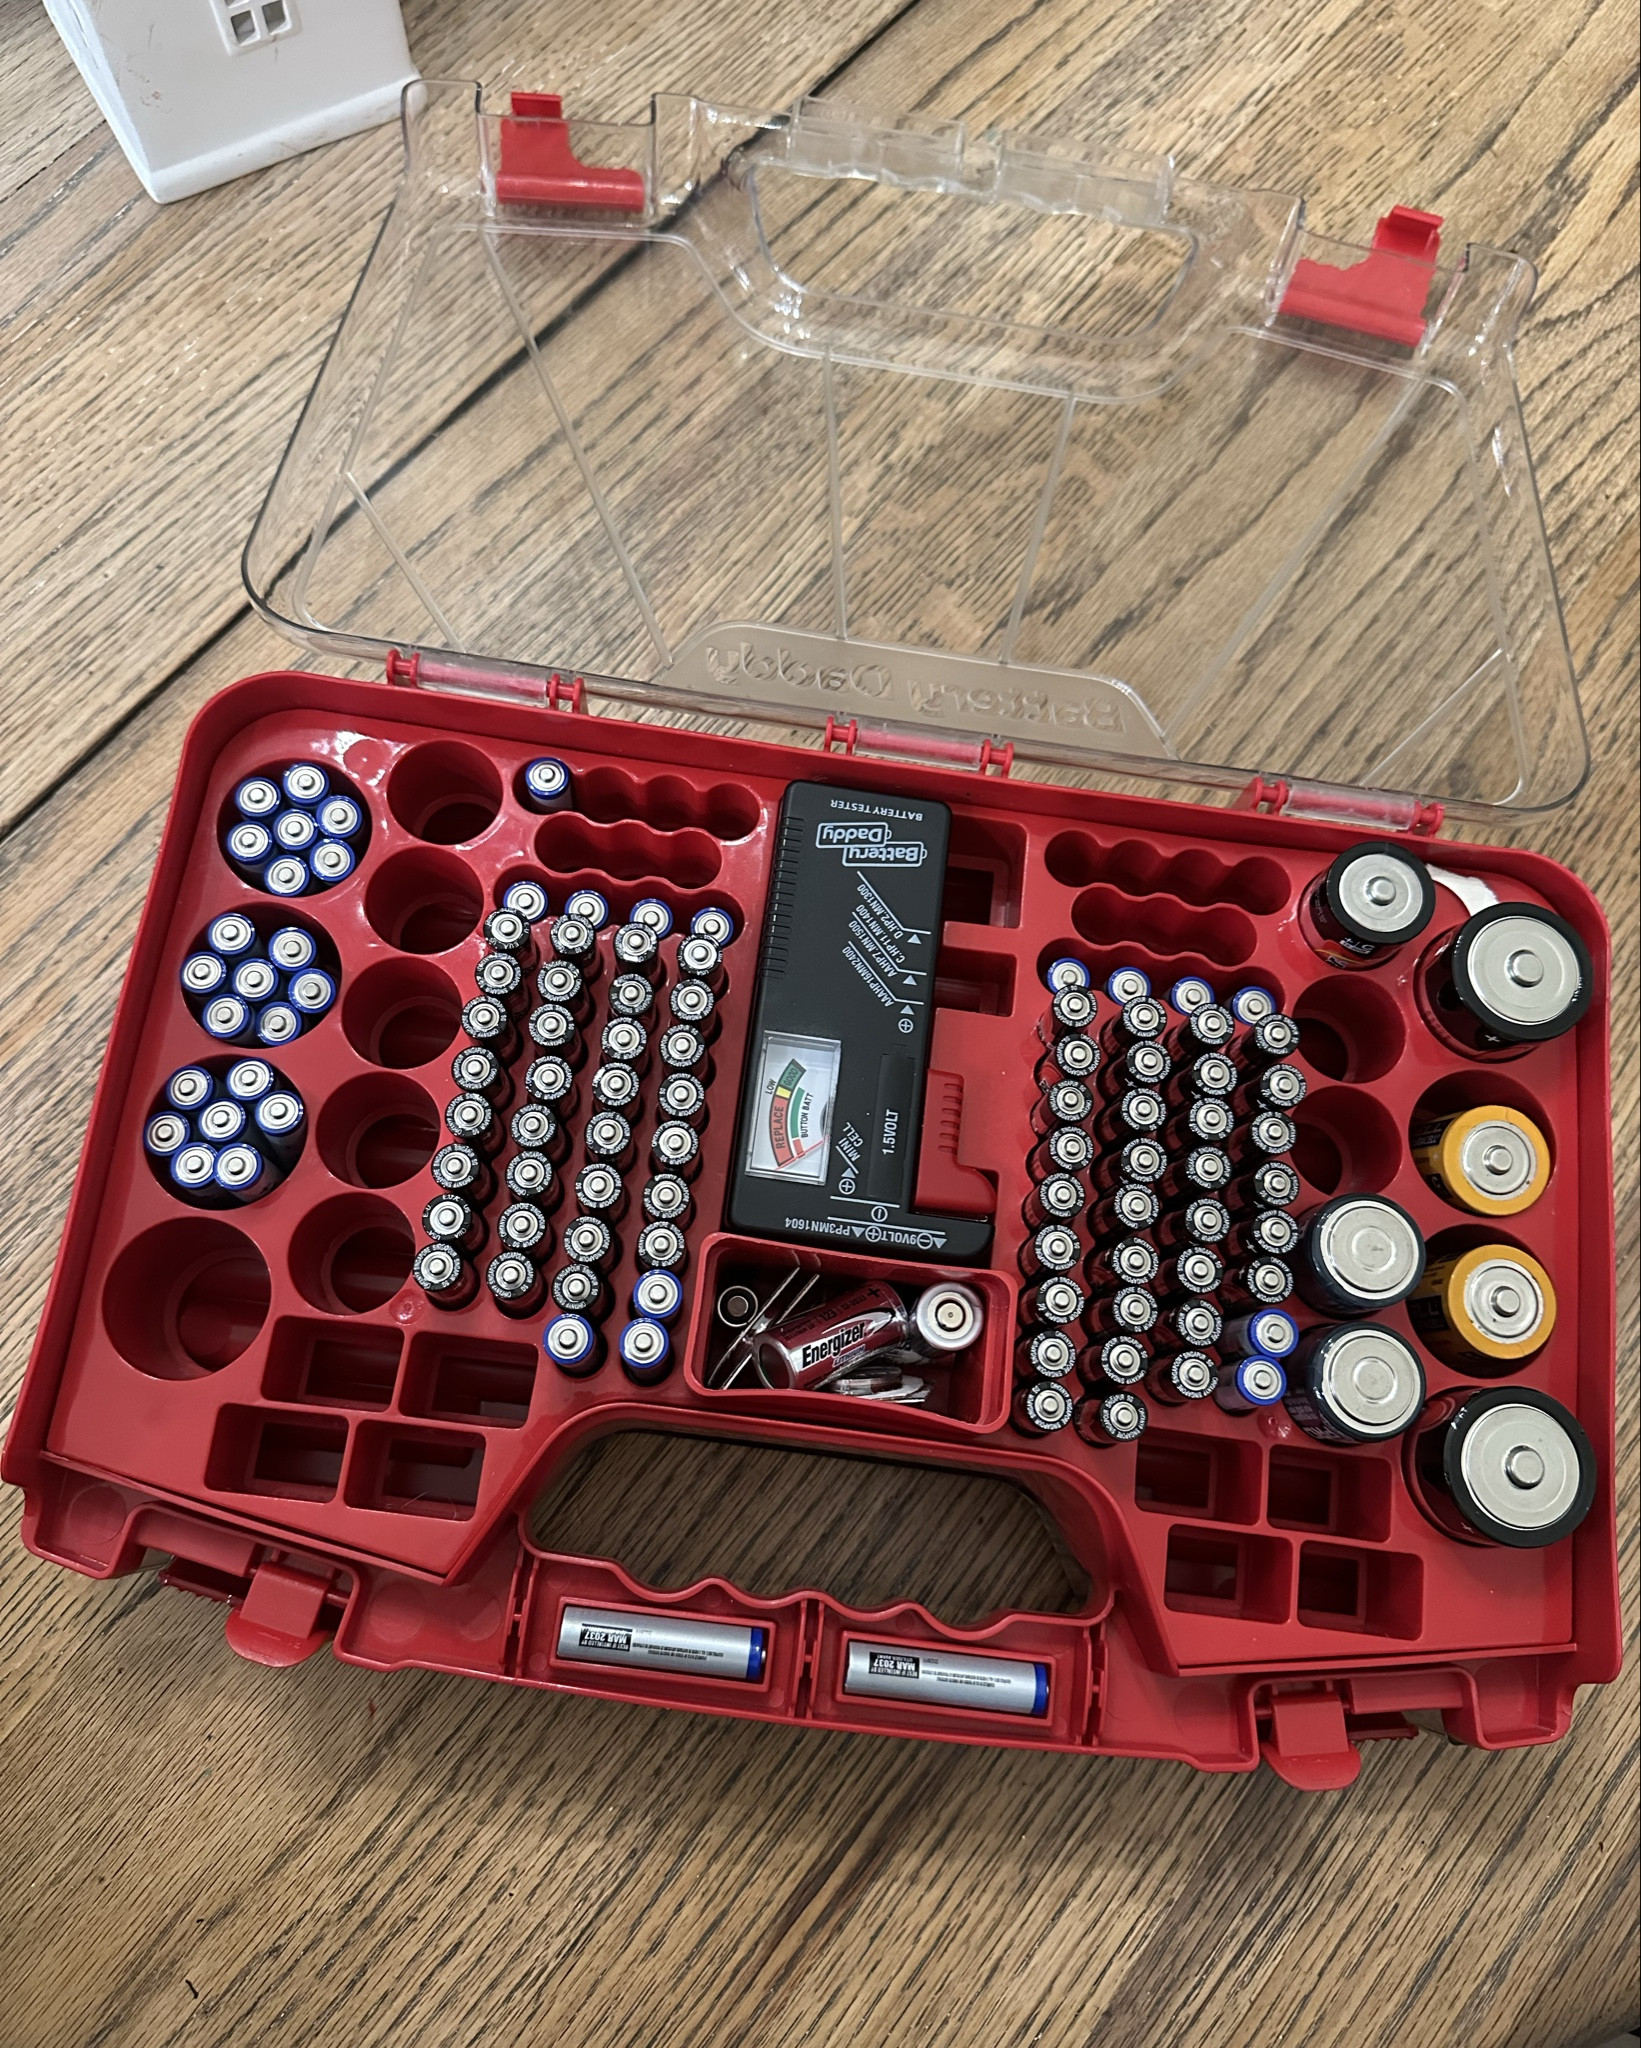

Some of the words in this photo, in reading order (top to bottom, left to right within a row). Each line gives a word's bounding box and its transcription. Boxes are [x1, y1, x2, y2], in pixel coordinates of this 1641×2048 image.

[830, 799, 872, 814] TESTER
[872, 806, 923, 821] BATTERY
[822, 826, 883, 843] Daddy
[848, 847, 919, 861] Battery
[857, 884, 904, 939] D.HP2.MN1300
[855, 904, 905, 963] C.HP11.MN1400
[848, 920, 898, 977] AAHP7.MN1500
[842, 946, 895, 1007] AAAHP16MN2400
[784, 1068, 799, 1086] GOOD
[765, 1079, 777, 1095] LOW
[803, 1093, 814, 1111] BATT
[774, 1106, 785, 1149] REPLACE
[800, 1112, 808, 1138] BUTTON
[882, 1109, 899, 1155] 1.5VOLT
[842, 1122, 864, 1147] CELL
[838, 1137, 861, 1162] MINI
[785, 1217, 850, 1236] PP3MN1604
[881, 1230, 917, 1245] 9VOLT
[802, 1322, 865, 1369] Energizer
[584, 1631, 605, 1642] 2037
[608, 1633, 628, 1644] MAR
[873, 1658, 895, 1669] 2037
[897, 1660, 916, 1671] MAR
